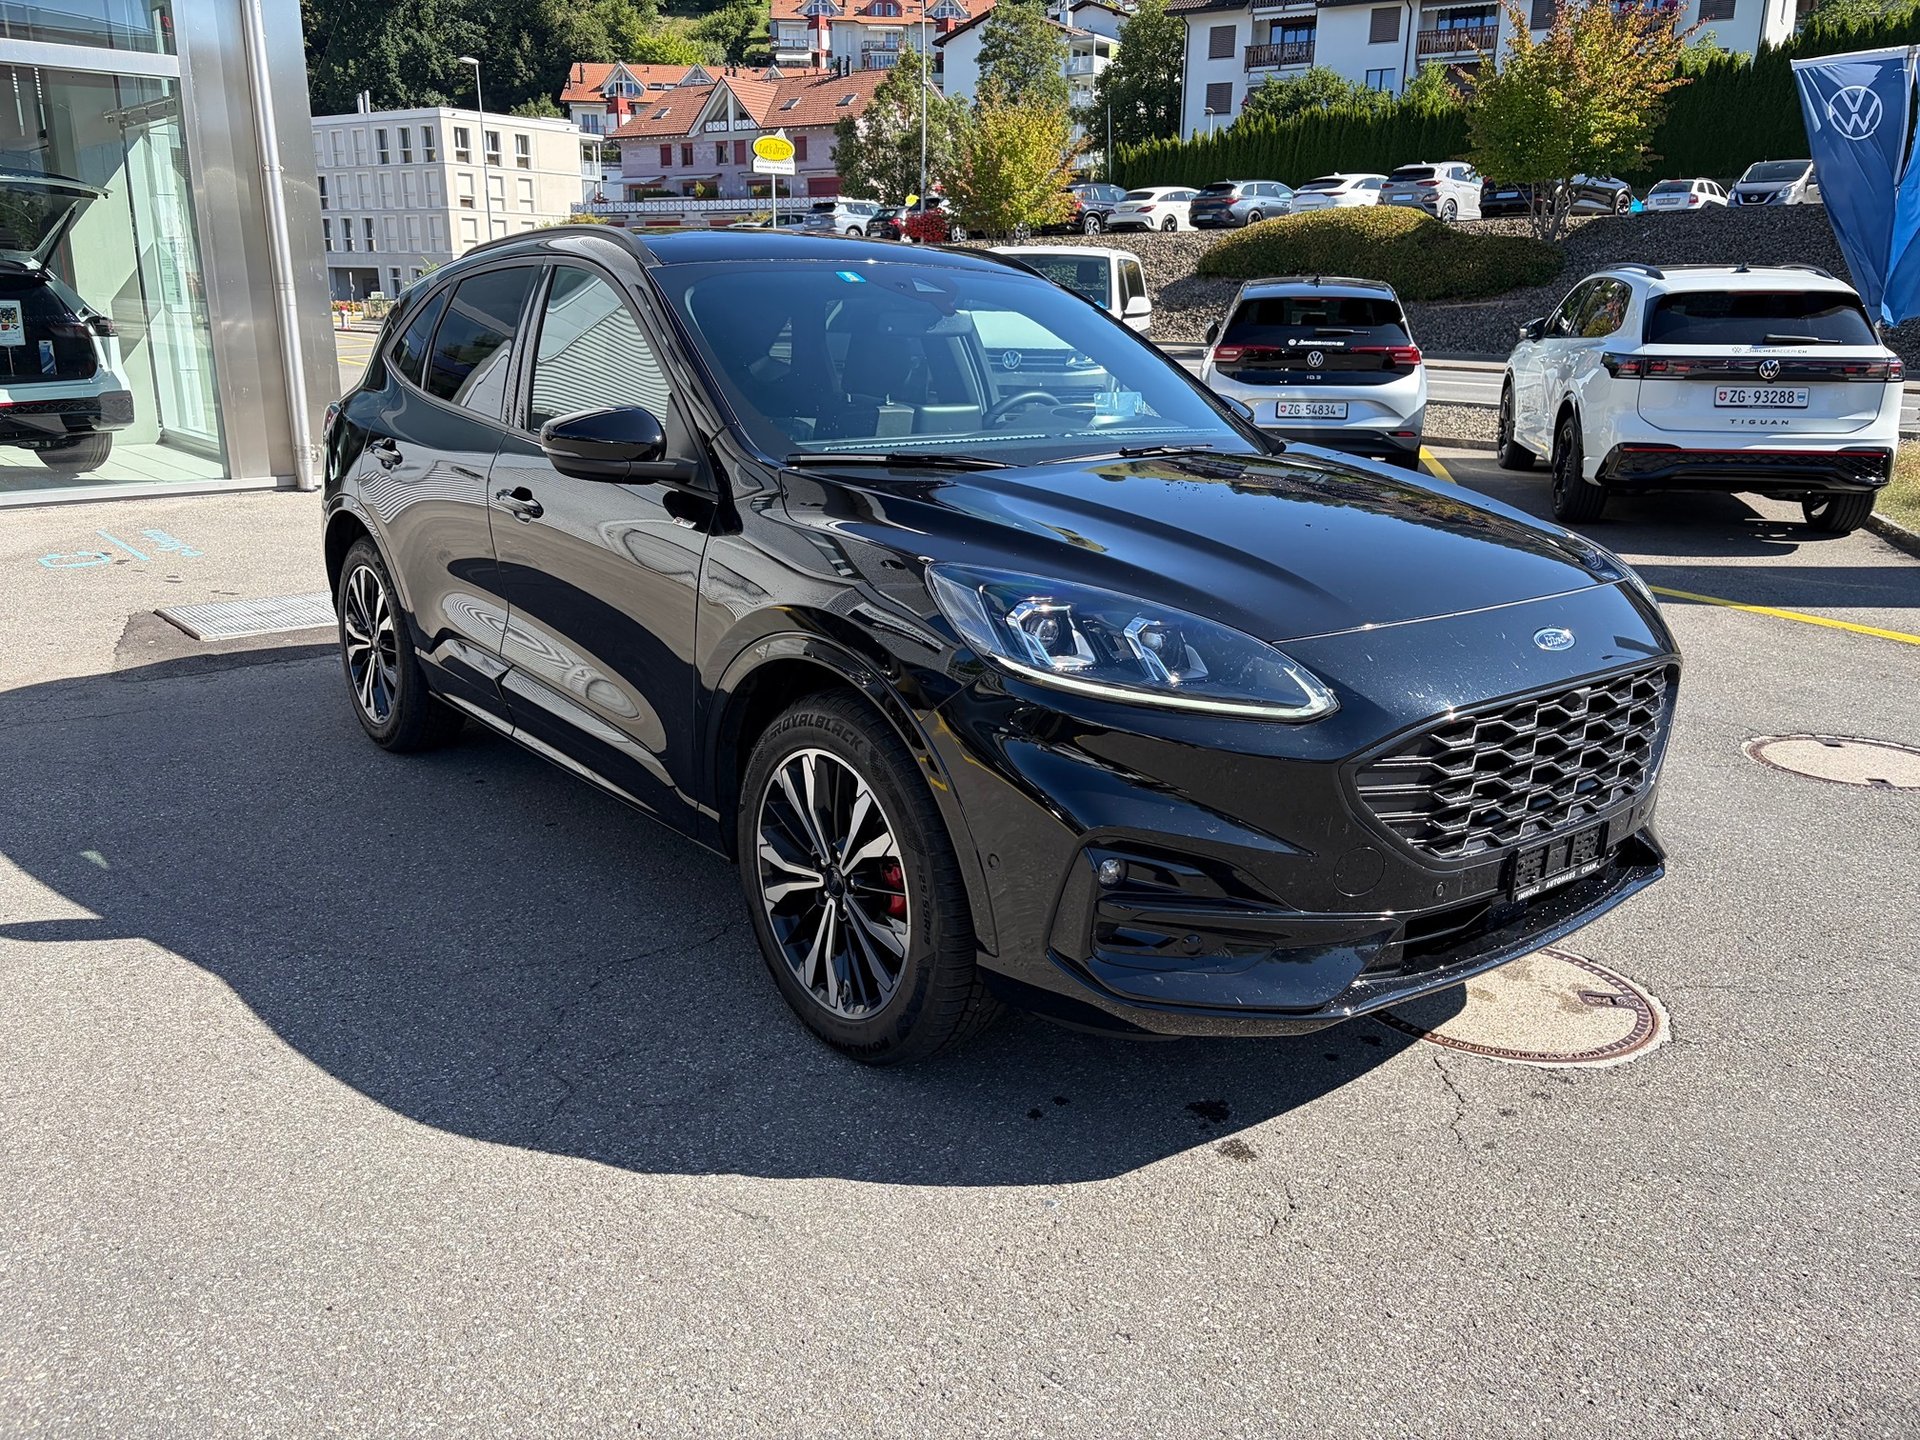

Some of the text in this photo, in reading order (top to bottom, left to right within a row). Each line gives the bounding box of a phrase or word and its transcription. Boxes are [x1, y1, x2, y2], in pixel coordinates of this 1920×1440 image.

[1730, 418, 1790, 426] TIGUAN
[768, 713, 864, 752] ROYALBLACK
[1545, 871, 1576, 889] AUTOHAUS
